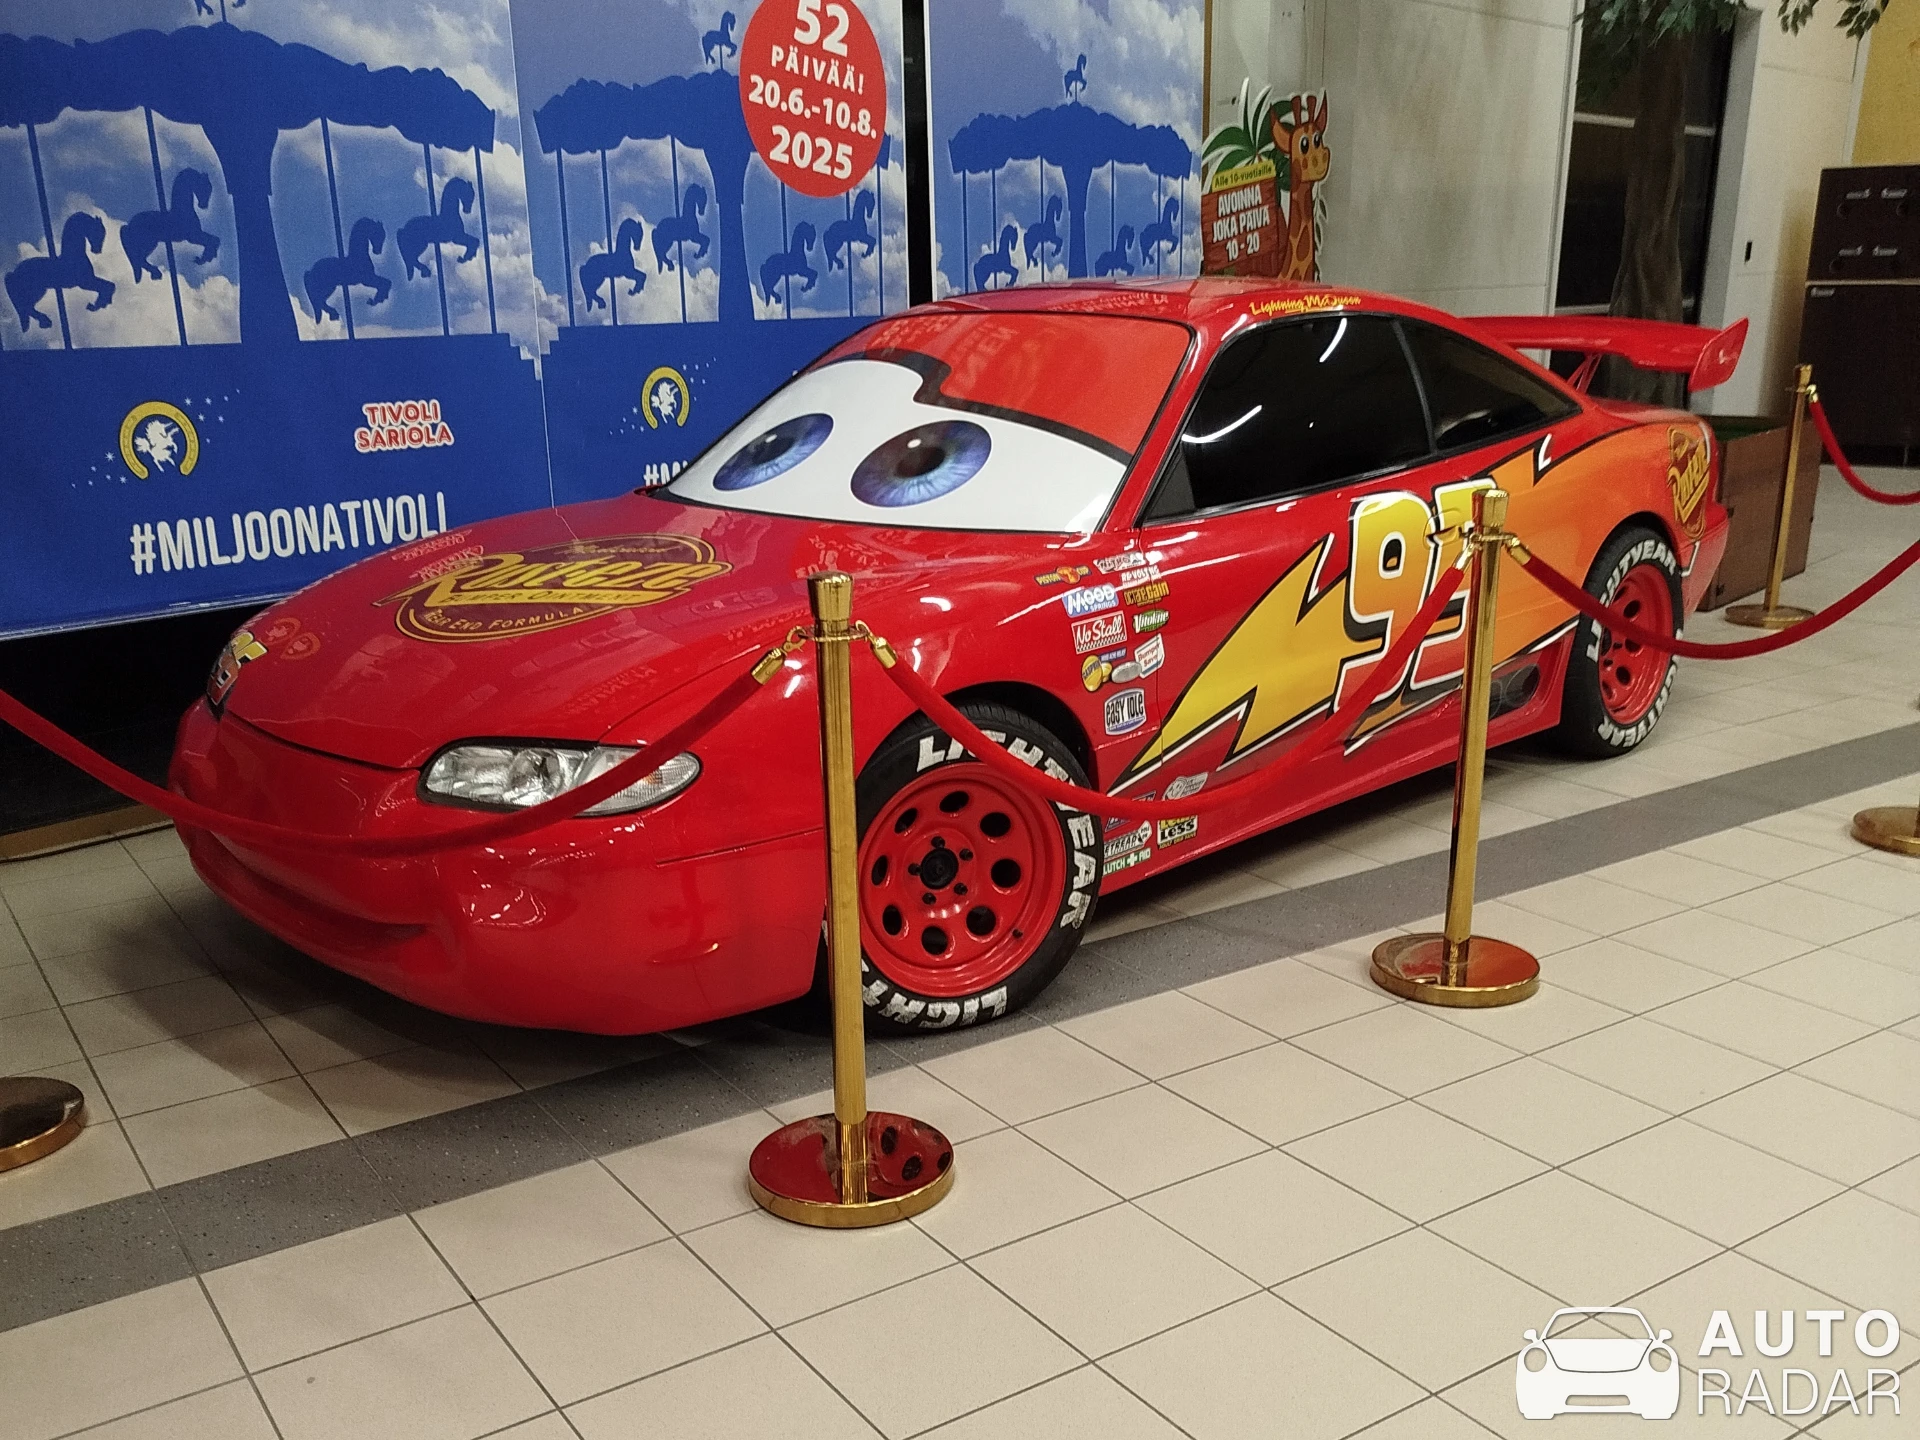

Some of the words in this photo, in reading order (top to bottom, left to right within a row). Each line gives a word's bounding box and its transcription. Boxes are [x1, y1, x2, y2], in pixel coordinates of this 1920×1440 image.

[794, 0, 850, 57] 52
[771, 44, 864, 96] PÄIVÄÄ!
[748, 74, 877, 140] 20.6.-10.8.
[769, 125, 853, 180] 2025
[1214, 174, 1229, 187] Alle
[1218, 184, 1262, 217] AVOINNA
[1212, 216, 1238, 243] JOKA
[1239, 204, 1271, 234] PÄIVÄ
[1226, 238, 1239, 262] 10
[1246, 232, 1260, 256] 20
[363, 400, 441, 426] TIVOLI
[355, 423, 453, 451] SARIOLA
[130, 491, 447, 575] #MILJOONATIVOLI
[1067, 585, 1115, 614] MOOD
[449, 618, 483, 631] END
[488, 606, 584, 631] FORMULA
[1076, 625, 1091, 646] No
[1092, 615, 1123, 641] Stall
[1160, 818, 1195, 842] Less
[1103, 857, 1126, 876] LUTCH
